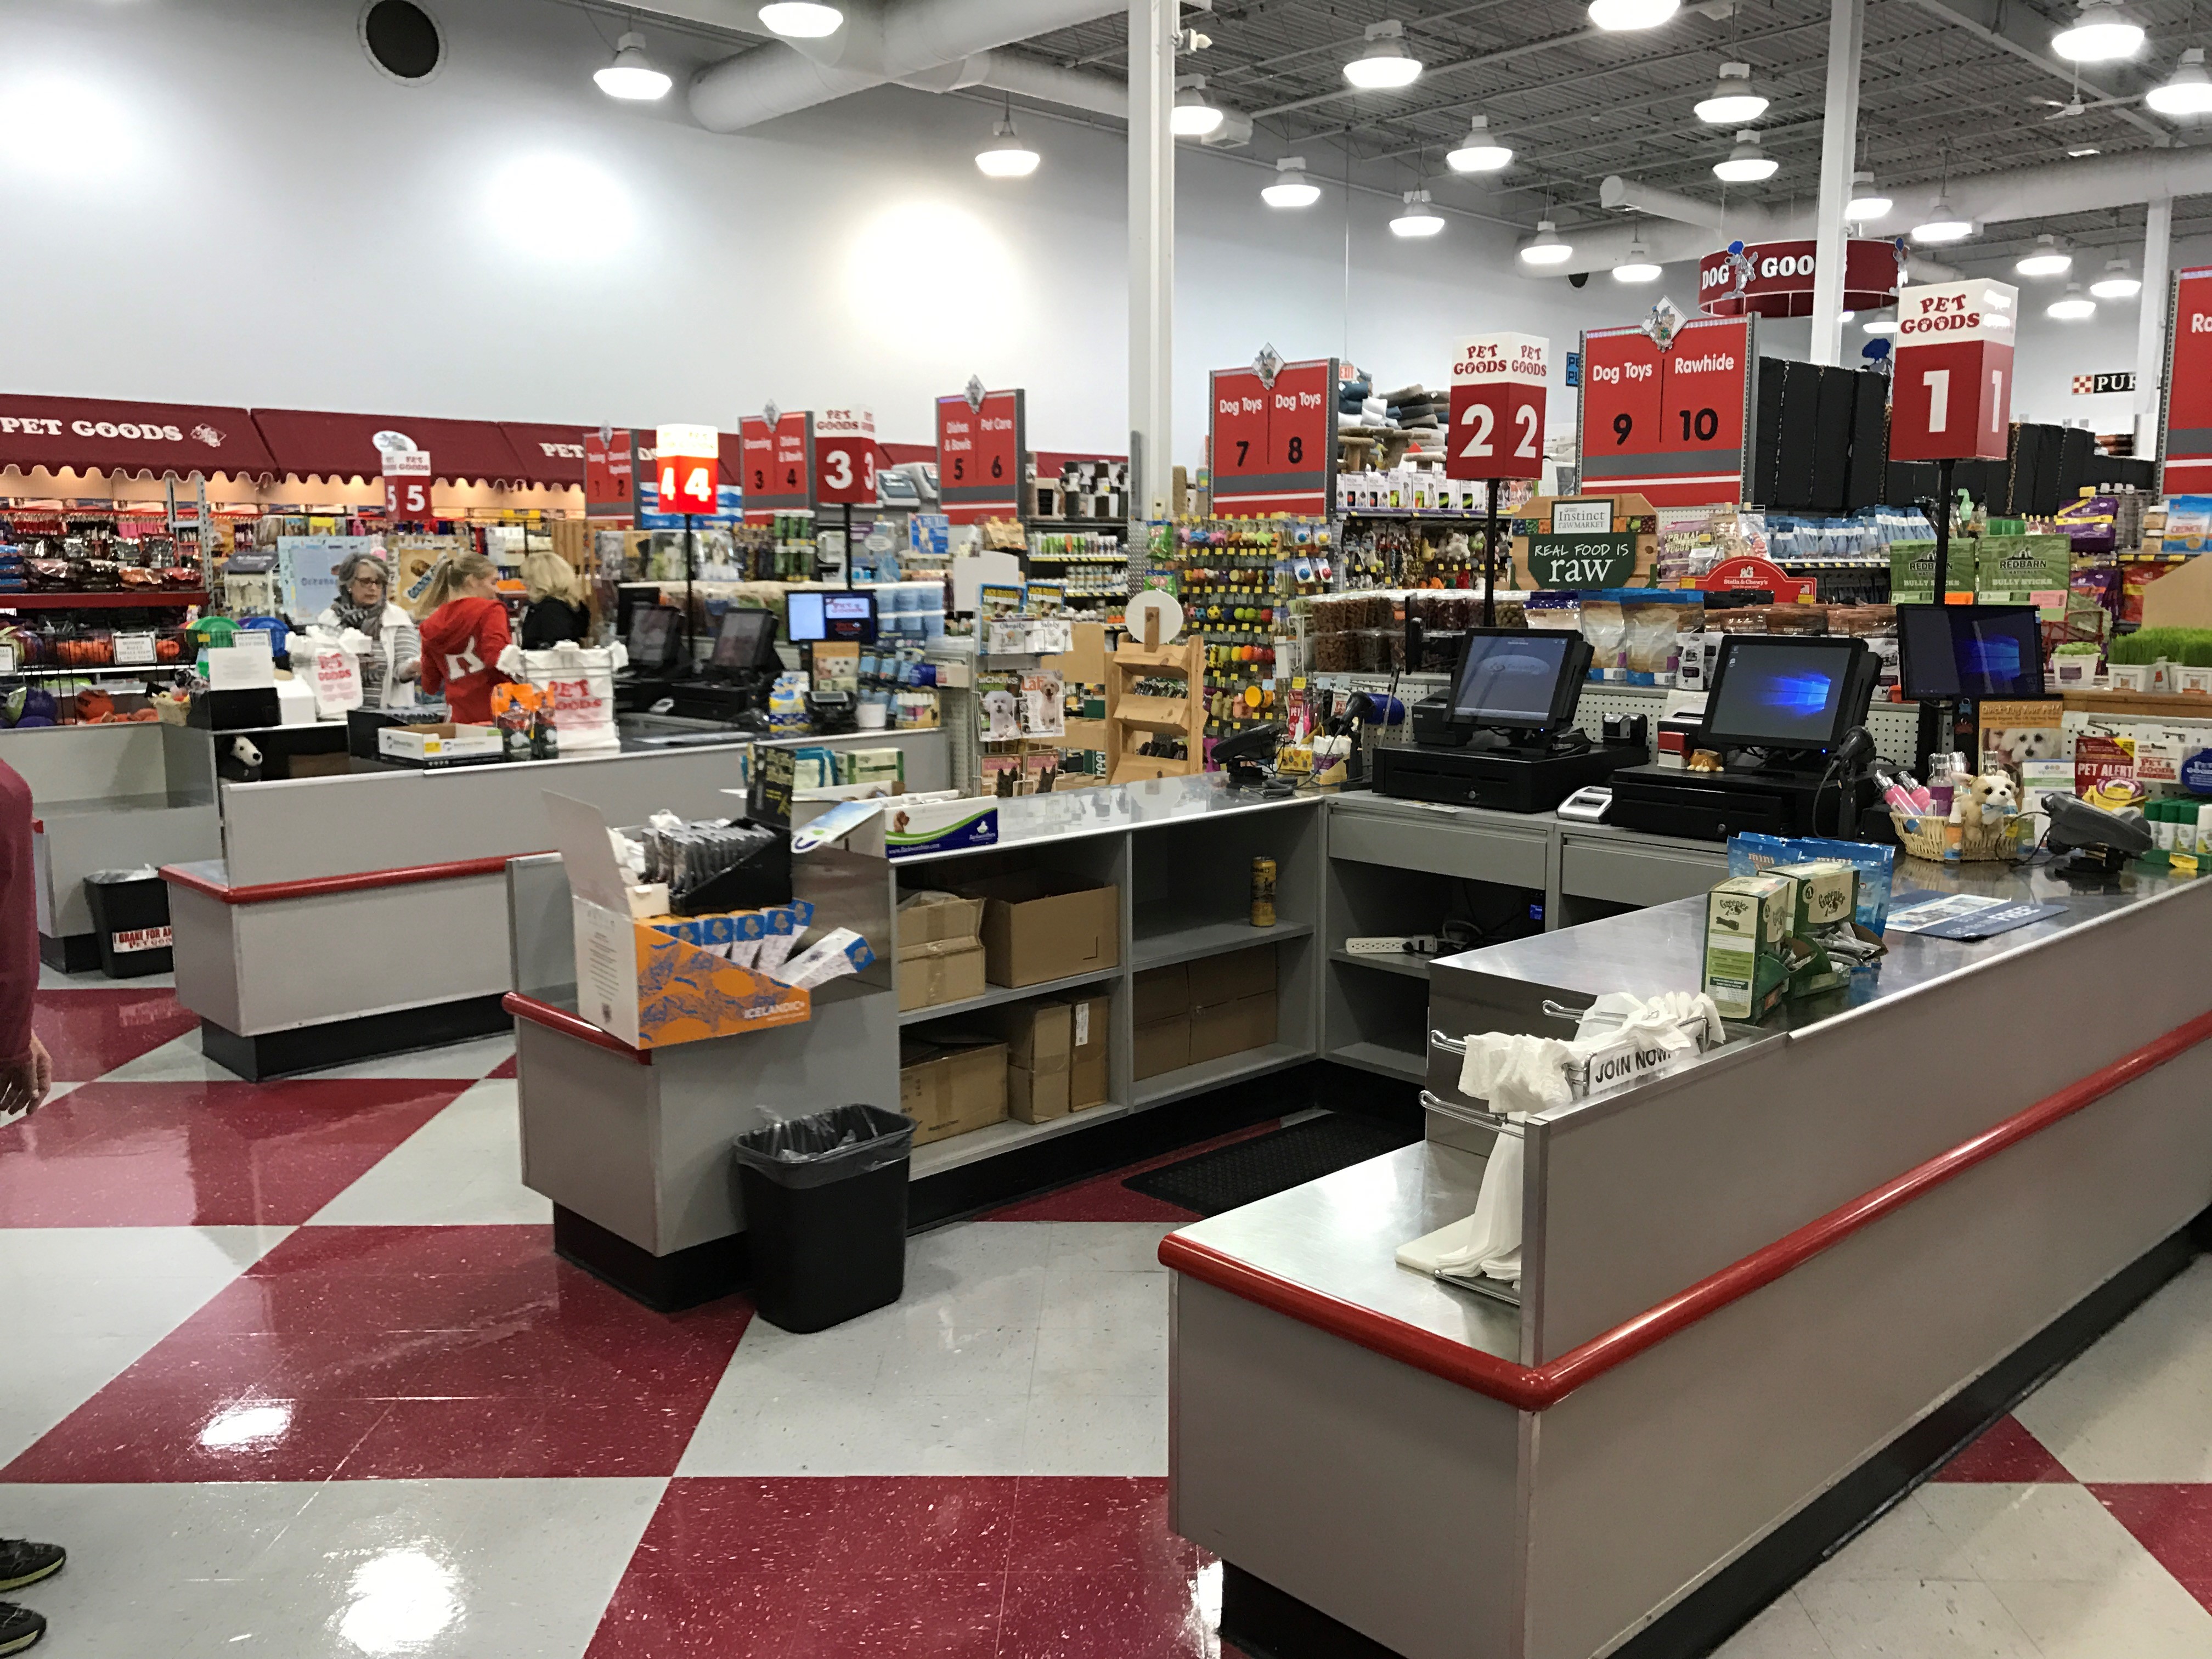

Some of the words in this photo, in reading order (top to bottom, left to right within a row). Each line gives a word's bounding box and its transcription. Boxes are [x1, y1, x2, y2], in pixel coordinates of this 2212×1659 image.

[1702, 264, 1729, 290] DOG
[1762, 255, 1814, 278] GOO
[1920, 294, 1966, 314] PET
[1900, 312, 1980, 334] GOODS
[2192, 313, 2212, 333] Ra
[1467, 345, 1498, 358] PET
[1520, 345, 1541, 361] PET
[1339, 366, 1353, 379] EXIT
[1453, 360, 1506, 375] GOODS
[1511, 360, 1547, 377] GOODS
[1593, 365, 1620, 383] Dog
[1624, 362, 1652, 378] Toys
[1675, 353, 1734, 374] Rawhide
[2097, 373, 2136, 391] PUR
[1220, 399, 1239, 416] Dog
[1242, 397, 1262, 413] Toys
[1275, 394, 1295, 410] Dog
[1299, 392, 1321, 407] Toys
[1923, 369, 1950, 433] 1
[1991, 370, 2002, 433] 1
[826, 410, 851, 420] PET
[1679, 408, 1718, 441] 10
[1, 417, 63, 436] PET
[72, 421, 183, 441] GOODS
[817, 421, 858, 430] GOODS
[1459, 404, 1494, 458] 2
[1514, 404, 1537, 458] 2
[1613, 413, 1632, 445] 9
[540, 443, 584, 459] PET
[1237, 441, 1249, 467] 7
[1288, 437, 1303, 464] 8
[824, 450, 853, 489] 3
[864, 452, 874, 490] 3
[953, 458, 964, 480] 5
[991, 455, 1003, 478] 6
[661, 467, 675, 500] 4
[684, 467, 712, 501] 4
[755, 470, 764, 490] 3
[787, 469, 796, 487] 4
[387, 485, 397, 512] 5
[407, 485, 425, 512] 5
[1559, 510, 1606, 521] Instinct
[1534, 545, 1569, 557] REAL
[1575, 543, 1612, 556] FOOD
[1617, 544, 1629, 556] IS
[1548, 558, 1614, 583] raw
[1910, 562, 1953, 571] REDBN
[1999, 560, 2047, 569] REDBARN
[978, 675, 1018, 684] BICHONS
[555, 698, 602, 710] OODS
[2078, 763, 2098, 776] PET
[2101, 764, 2134, 777] ALERT
[1748, 853, 1775, 865] mini
[1719, 899, 1750, 911] Greenies
[1818, 888, 1846, 909] Greenies
[1595, 1054, 1631, 1084] JOIN
